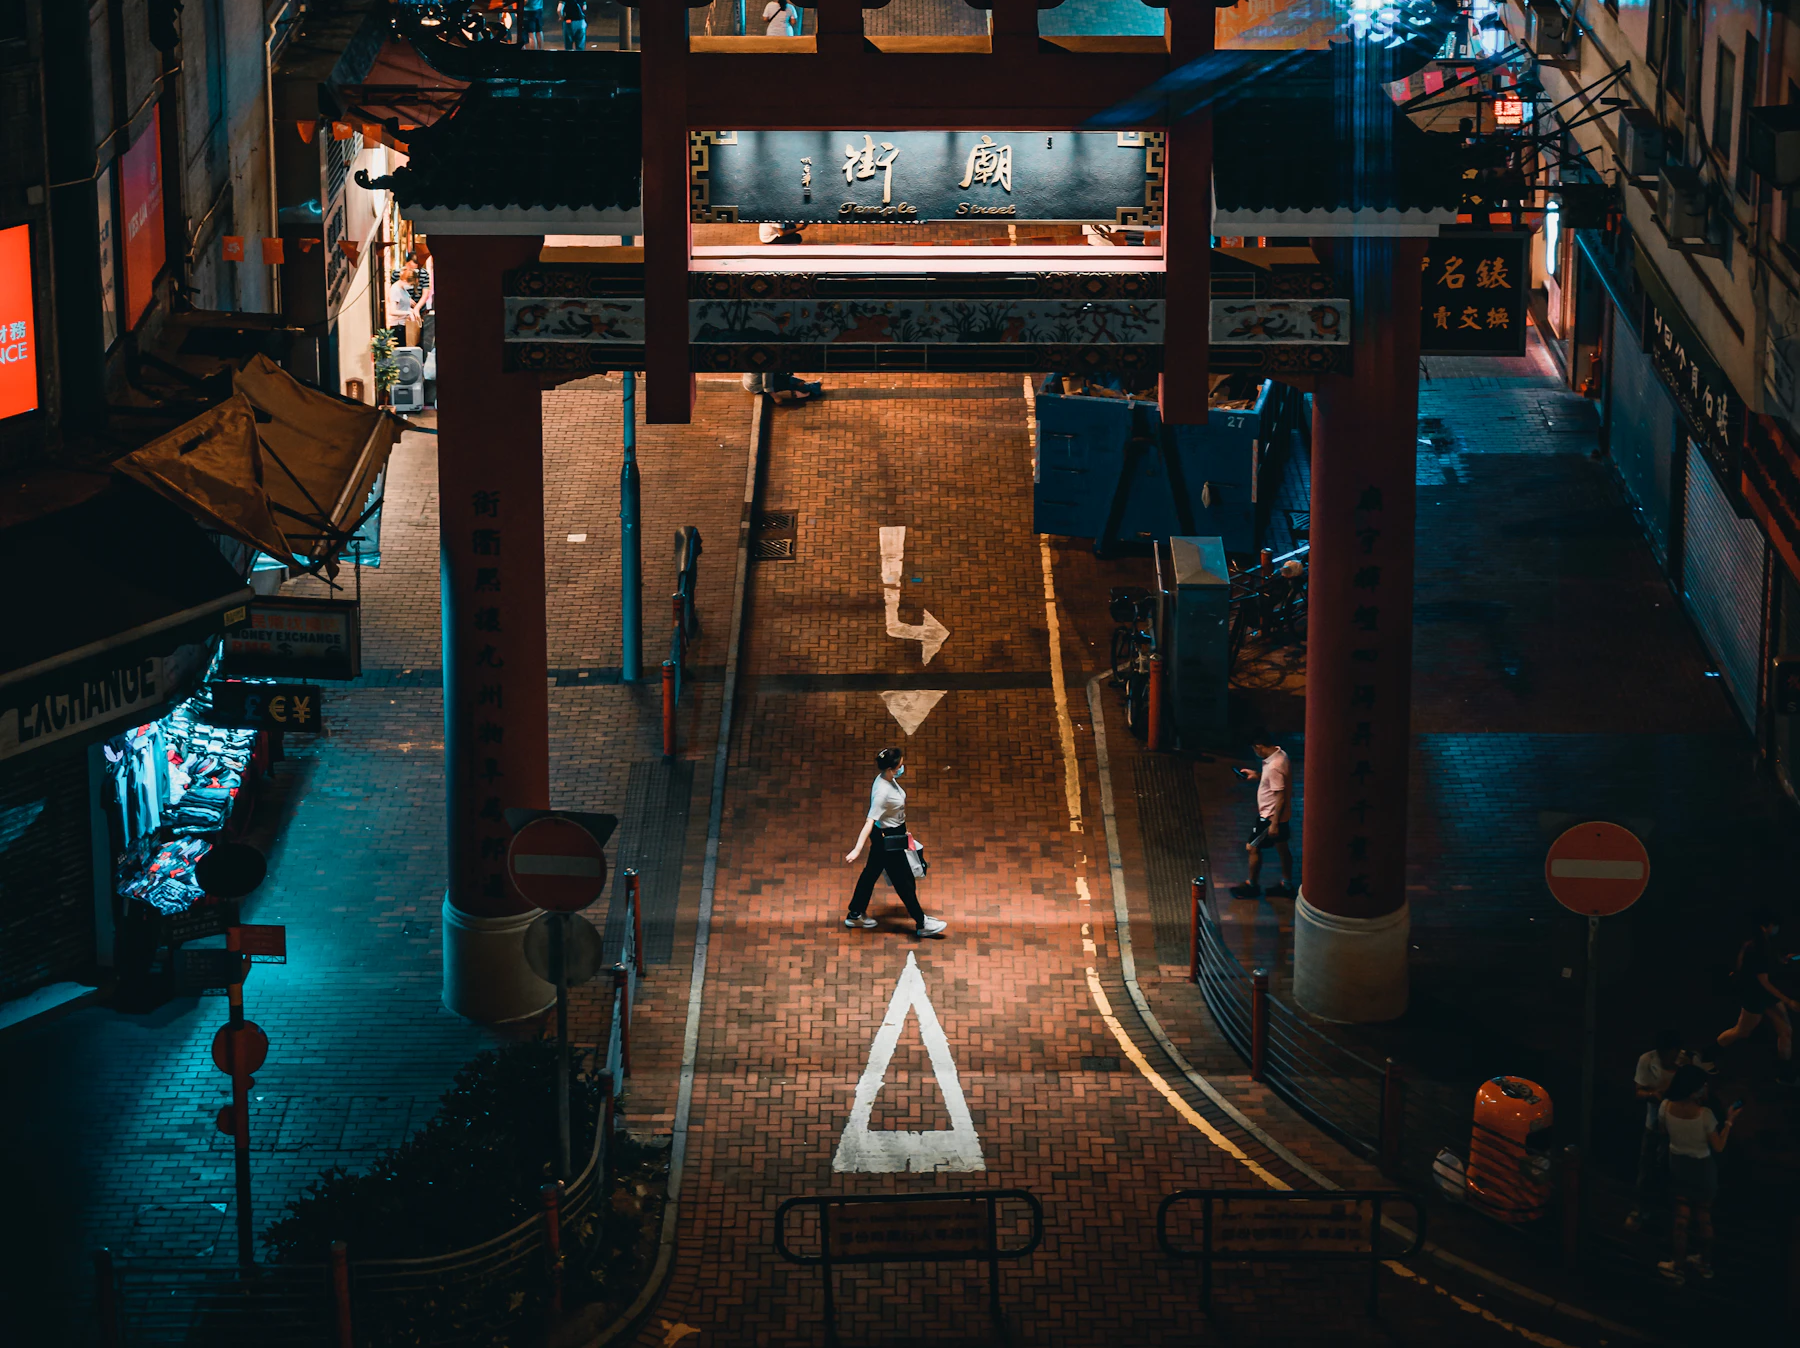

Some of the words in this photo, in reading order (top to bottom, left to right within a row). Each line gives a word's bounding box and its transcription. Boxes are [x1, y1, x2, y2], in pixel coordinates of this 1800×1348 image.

[837, 201, 918, 217] Temple
[955, 201, 1016, 216] Street
[1421, 254, 1514, 290] 名錶
[1420, 305, 1511, 331] 賣交換
[1227, 415, 1246, 430] 27
[276, 631, 342, 645] EXCHANGE
